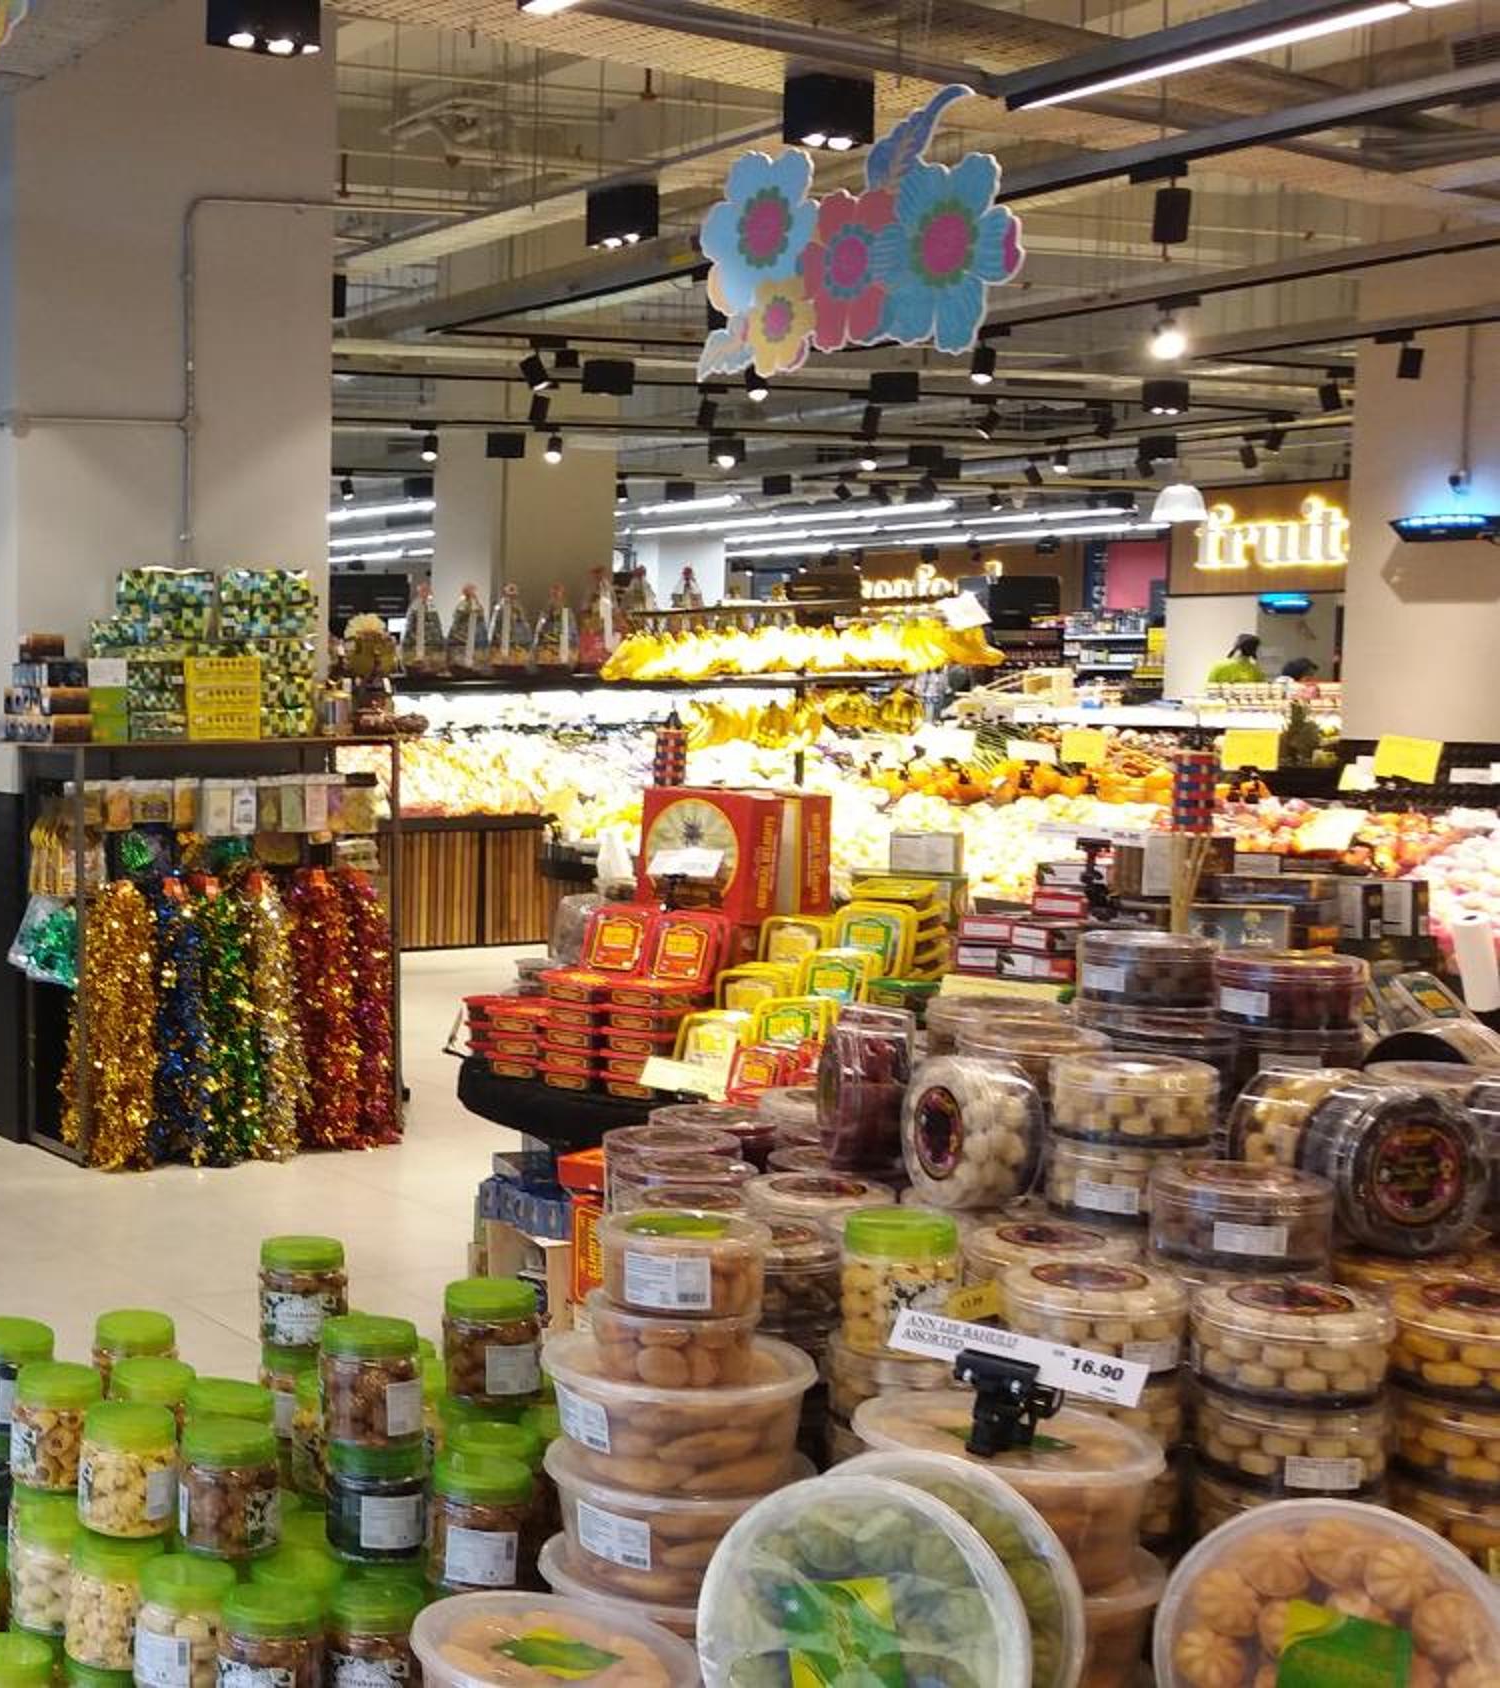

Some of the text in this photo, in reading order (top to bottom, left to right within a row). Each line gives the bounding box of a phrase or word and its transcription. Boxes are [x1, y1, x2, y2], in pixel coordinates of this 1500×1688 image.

[1194, 496, 1350, 569] fruit
[901, 1327, 965, 1352] ASSORTED
[1071, 1357, 1125, 1381] 16.90
